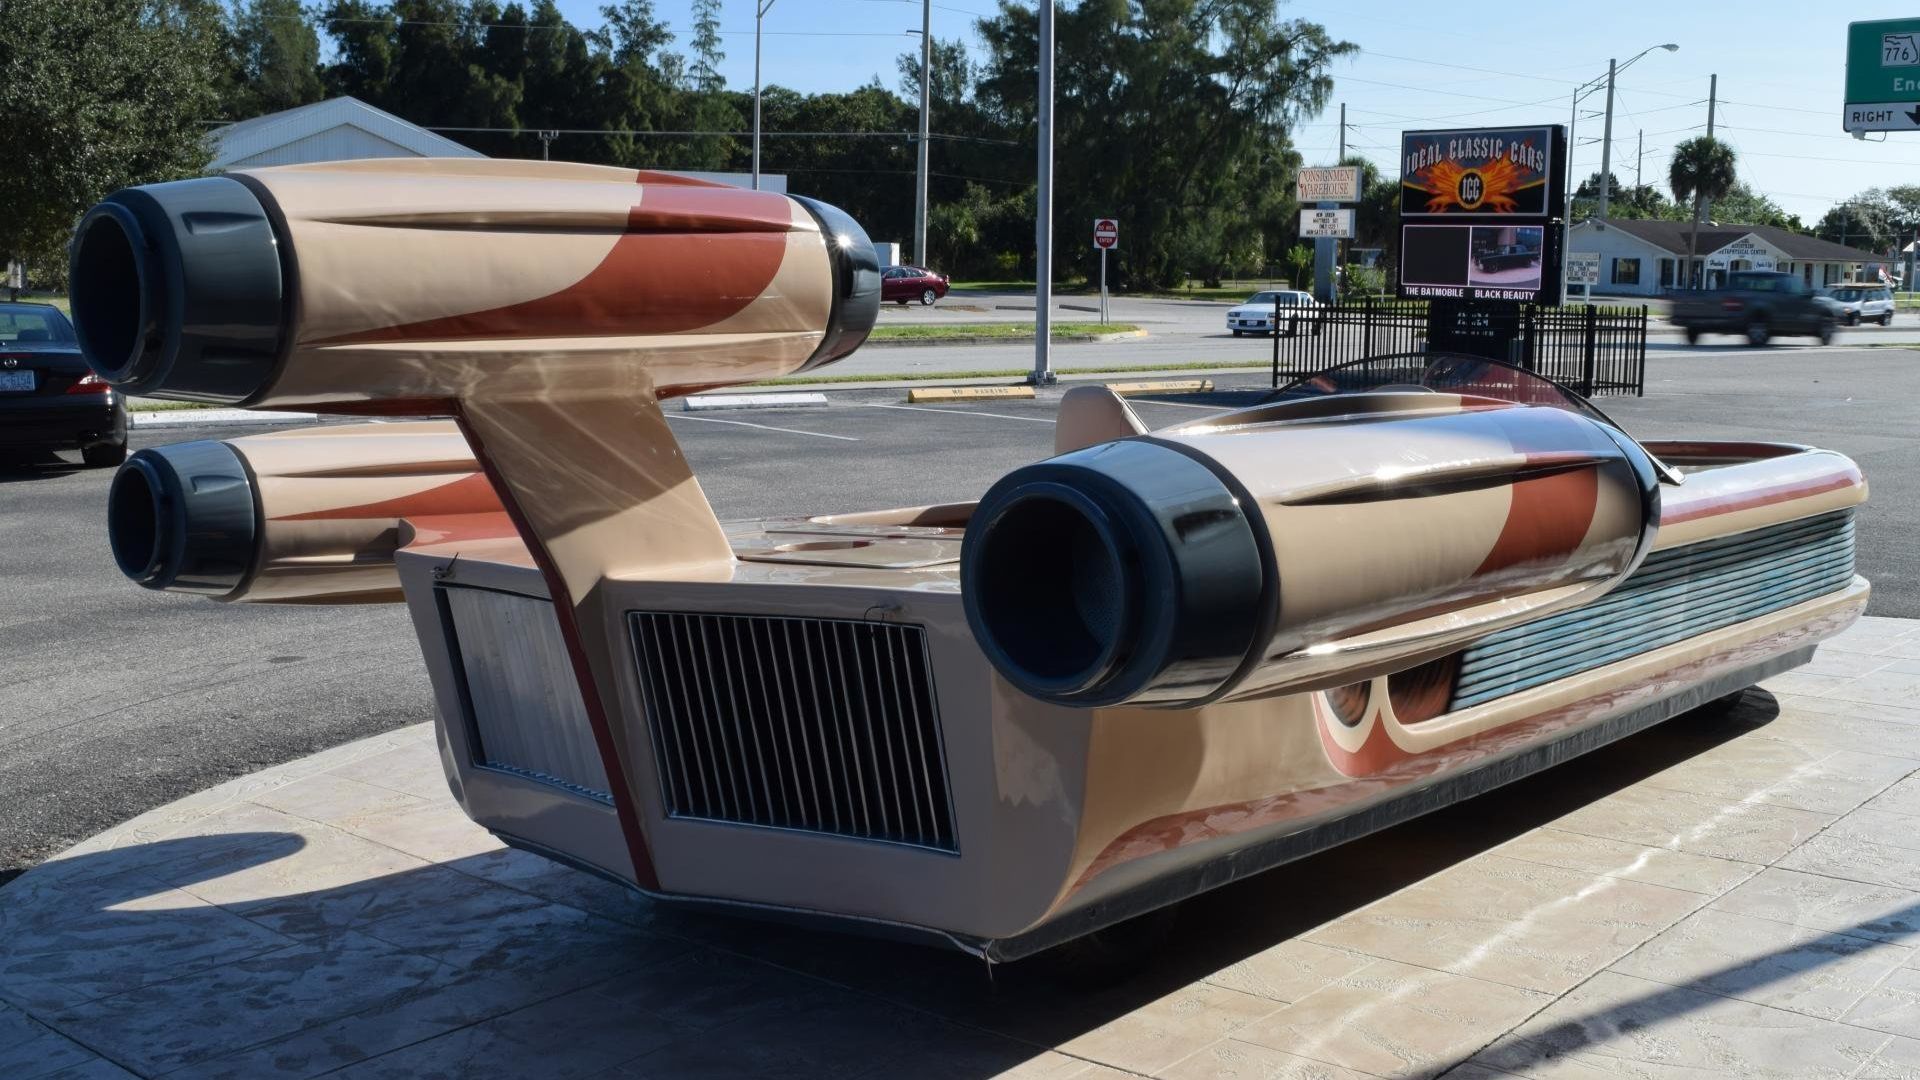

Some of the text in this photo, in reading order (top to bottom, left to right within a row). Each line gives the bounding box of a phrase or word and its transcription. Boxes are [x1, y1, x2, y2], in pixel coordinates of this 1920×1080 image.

[1885, 48, 1909, 61] 776
[1893, 77, 1920, 91] En
[1852, 110, 1894, 122] RIGHT
[1406, 137, 1544, 175] IDEAL CLASSIC CARS
[1298, 169, 1355, 187] CONSIGNMENT
[1301, 182, 1349, 198] WAREHOUSE
[1462, 177, 1480, 200] ICC
[1405, 287, 1464, 298] THE BATMOBILE
[1474, 290, 1535, 300] BLACK BEAUTY
